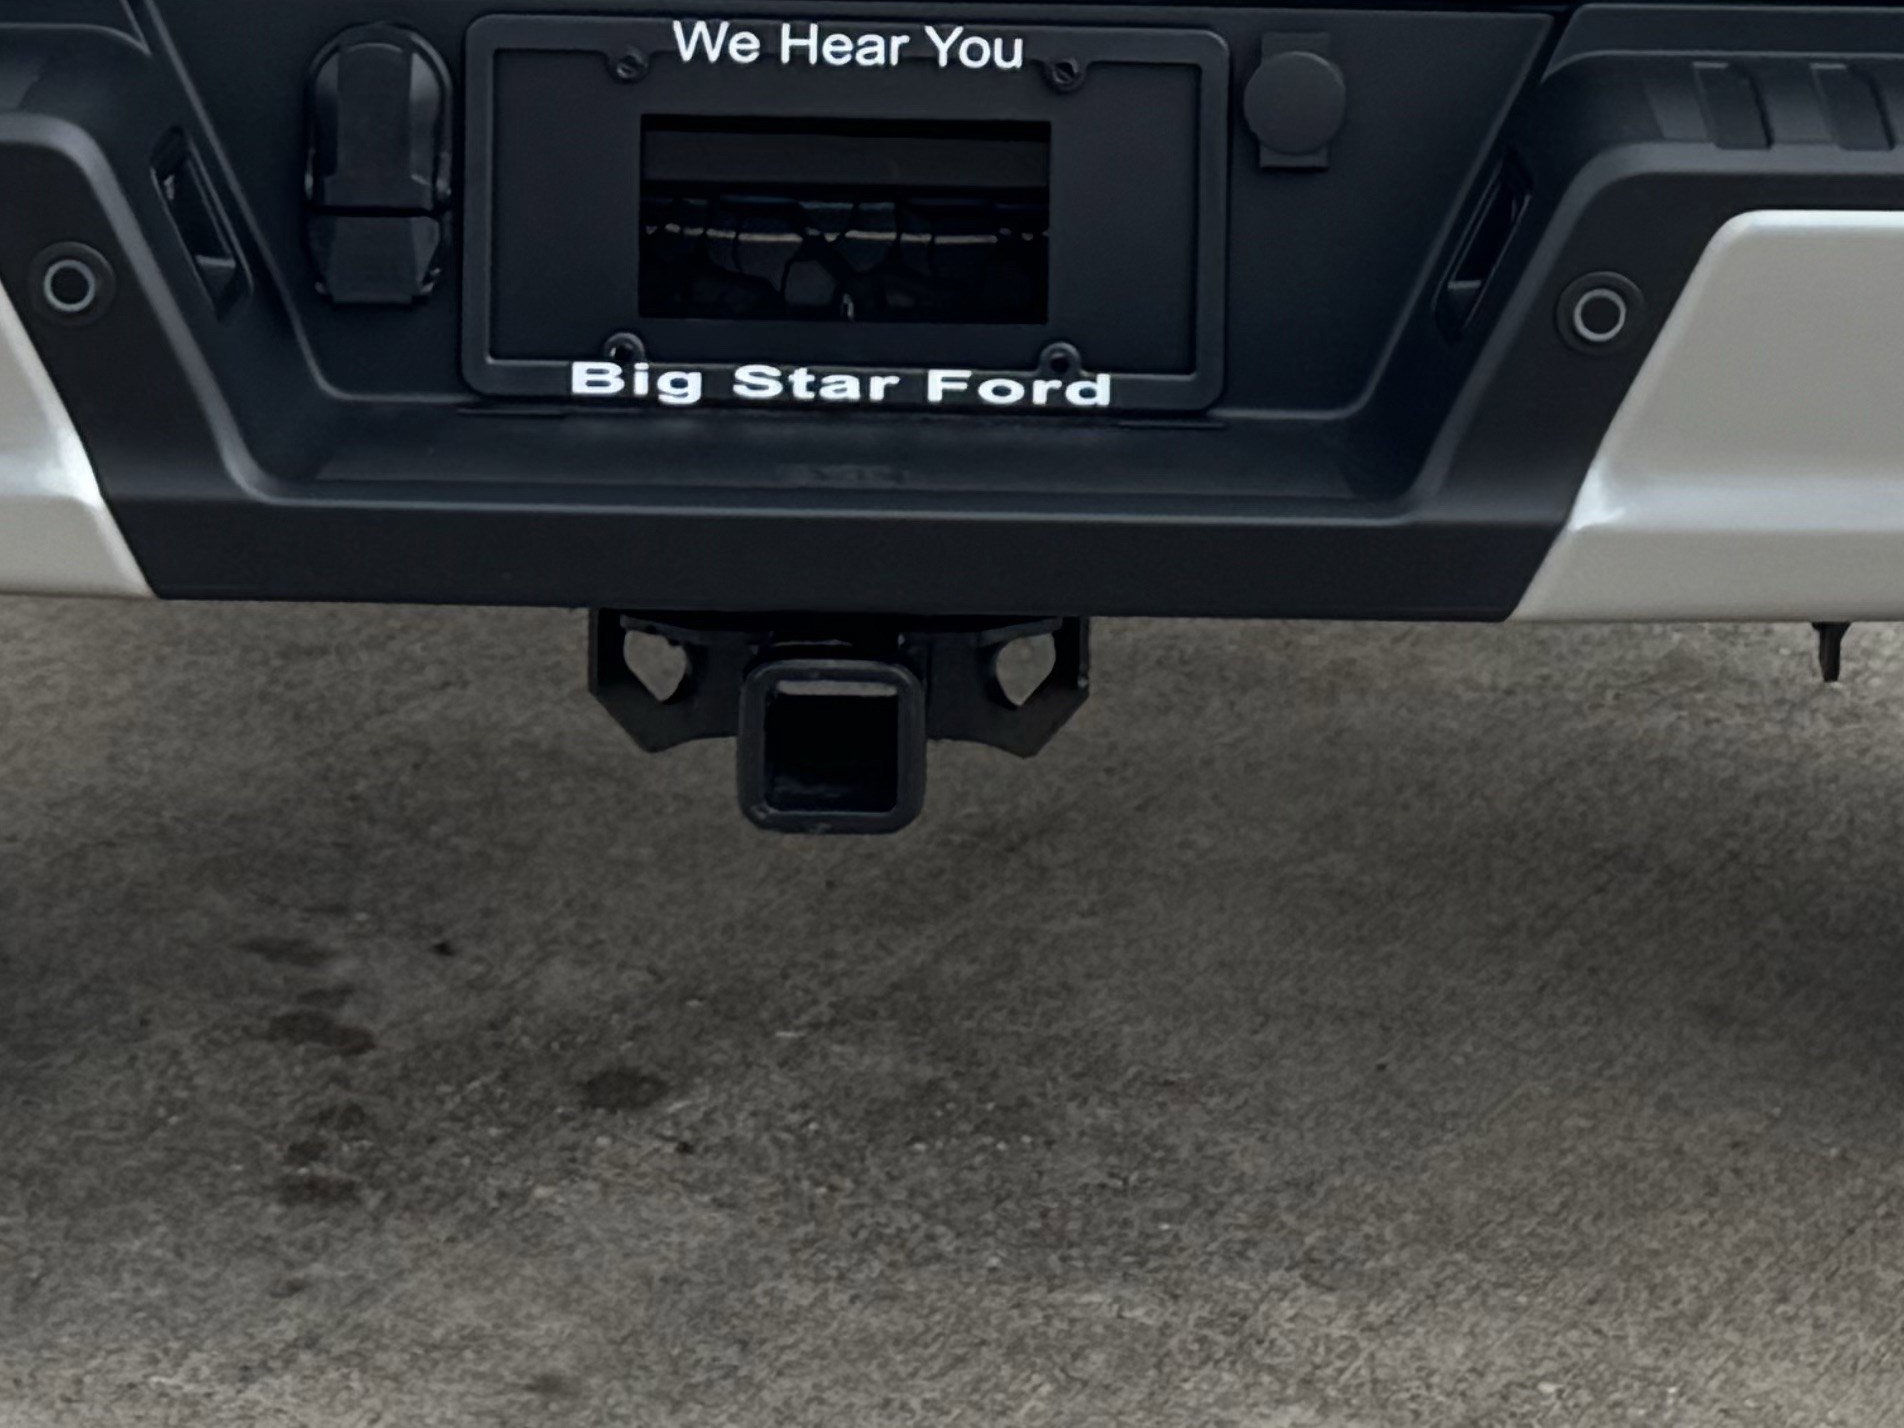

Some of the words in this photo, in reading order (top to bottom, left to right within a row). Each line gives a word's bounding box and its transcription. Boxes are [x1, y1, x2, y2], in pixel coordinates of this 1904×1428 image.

[673, 20, 761, 65] We
[780, 24, 910, 68] Hear
[924, 24, 1025, 72] You
[571, 361, 704, 406] Big
[733, 365, 901, 402] Star
[927, 370, 1114, 408] Ford
